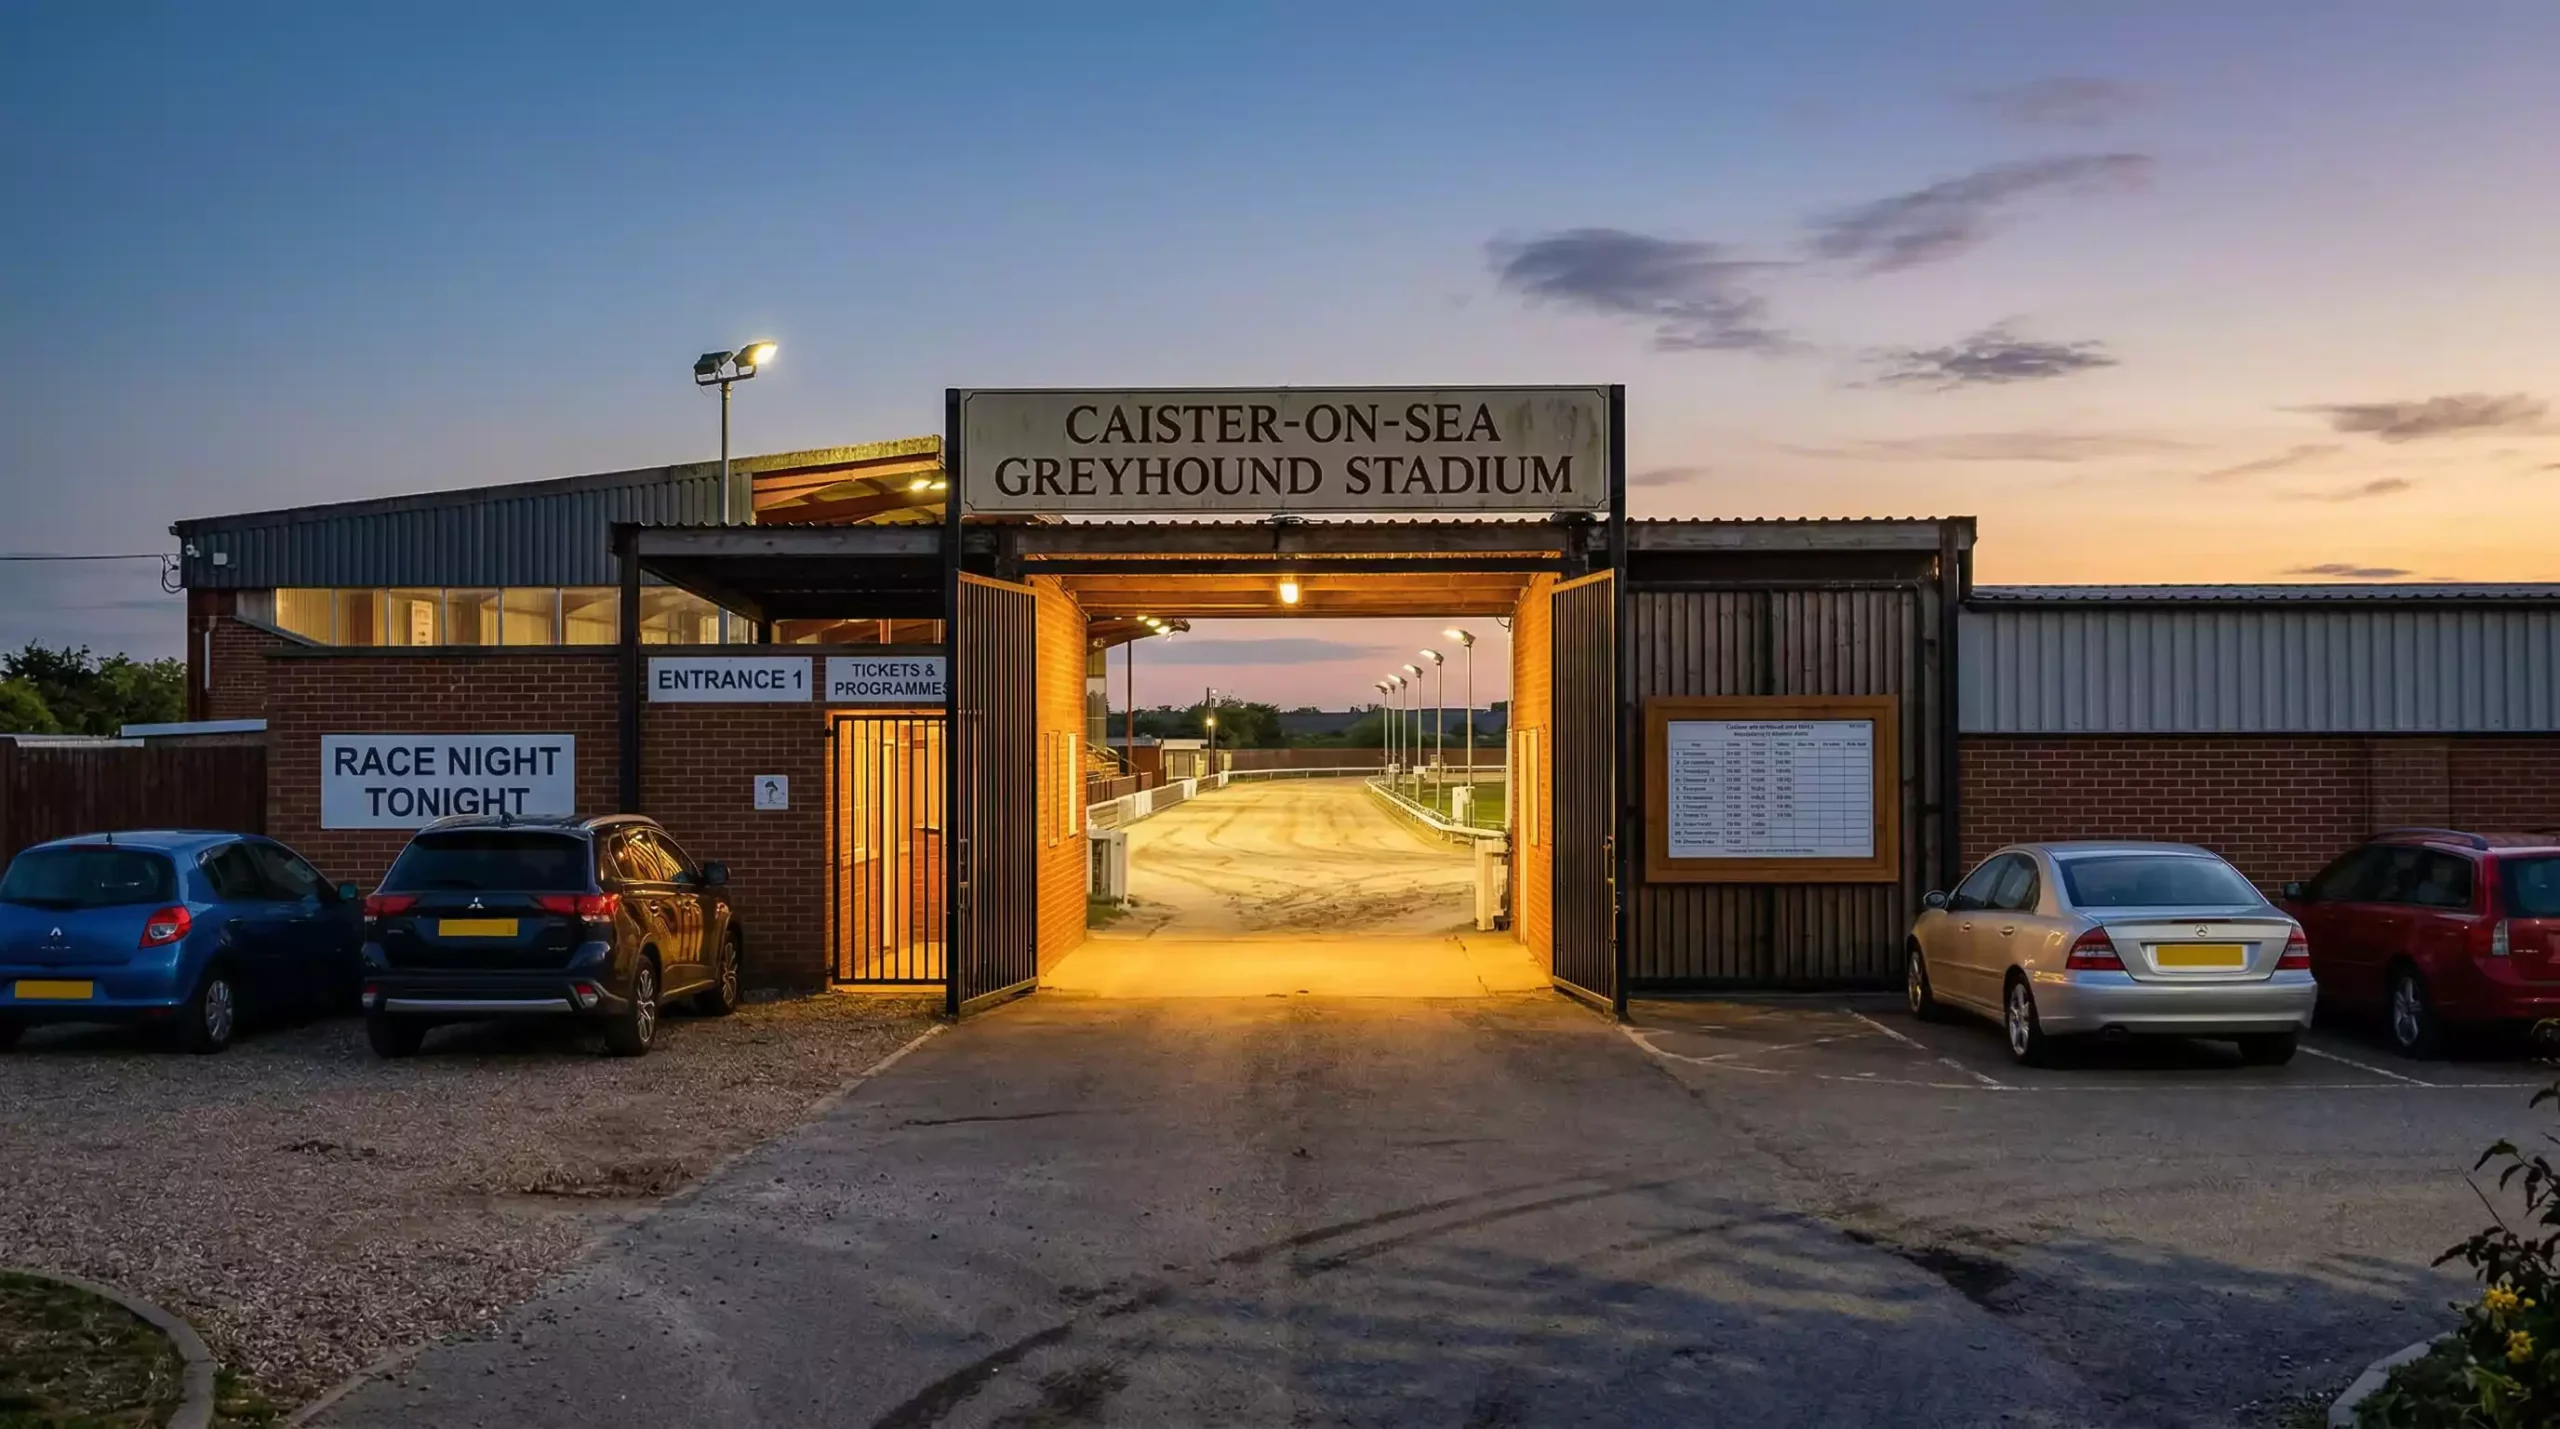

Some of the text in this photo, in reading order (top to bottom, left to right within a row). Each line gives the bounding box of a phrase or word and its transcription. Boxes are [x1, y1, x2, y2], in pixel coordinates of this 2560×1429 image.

[1066, 403, 1501, 444] CAISTER-ON-SEA
[996, 456, 1573, 496] GREYHOUND STADIUM
[658, 669, 802, 690] ENTRANCE 1
[852, 663, 935, 677] TICKETS &
[335, 746, 561, 776] RACE NIGHT
[365, 787, 530, 817] TONIGHT
